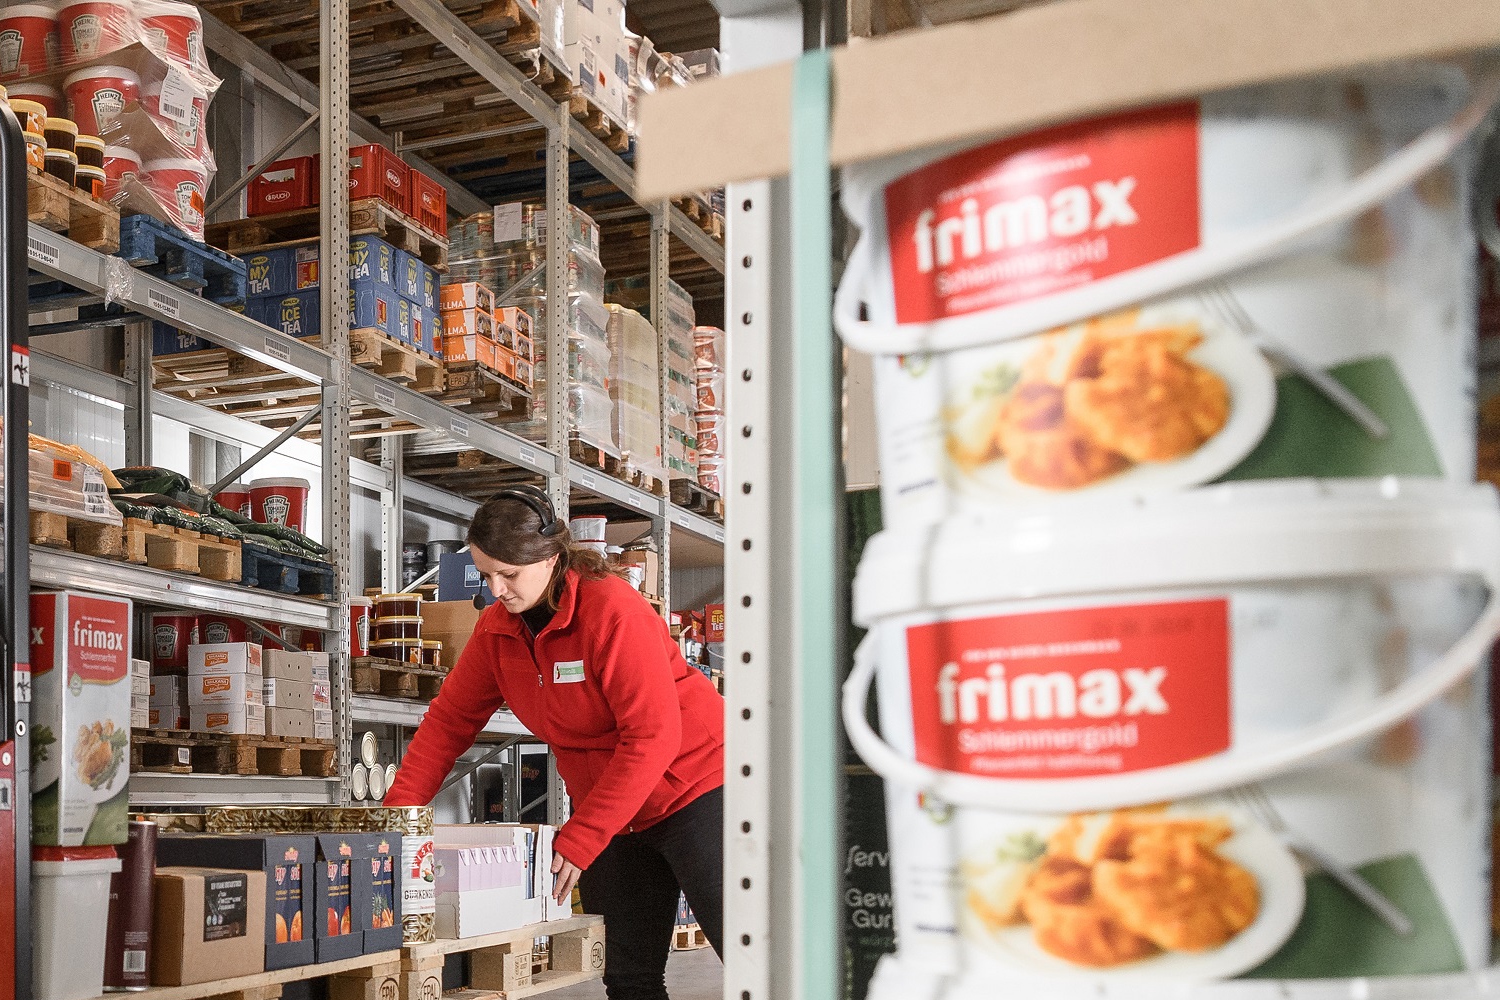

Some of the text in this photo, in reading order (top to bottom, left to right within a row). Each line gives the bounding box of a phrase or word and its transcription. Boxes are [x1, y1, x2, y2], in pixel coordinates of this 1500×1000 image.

[76, 17, 95, 26] HEINZ
[100, 92, 119, 100] HEINZ
[268, 193, 288, 201] RAUCH
[914, 175, 1140, 274] frimax
[249, 265, 269, 281] MY
[349, 263, 370, 280] TEA
[249, 277, 270, 294] TEA
[281, 307, 300, 322] ICE
[281, 320, 301, 335] TEA
[467, 570, 481, 580] Köll
[73, 620, 123, 651] frimax
[936, 660, 1170, 726] frimax
